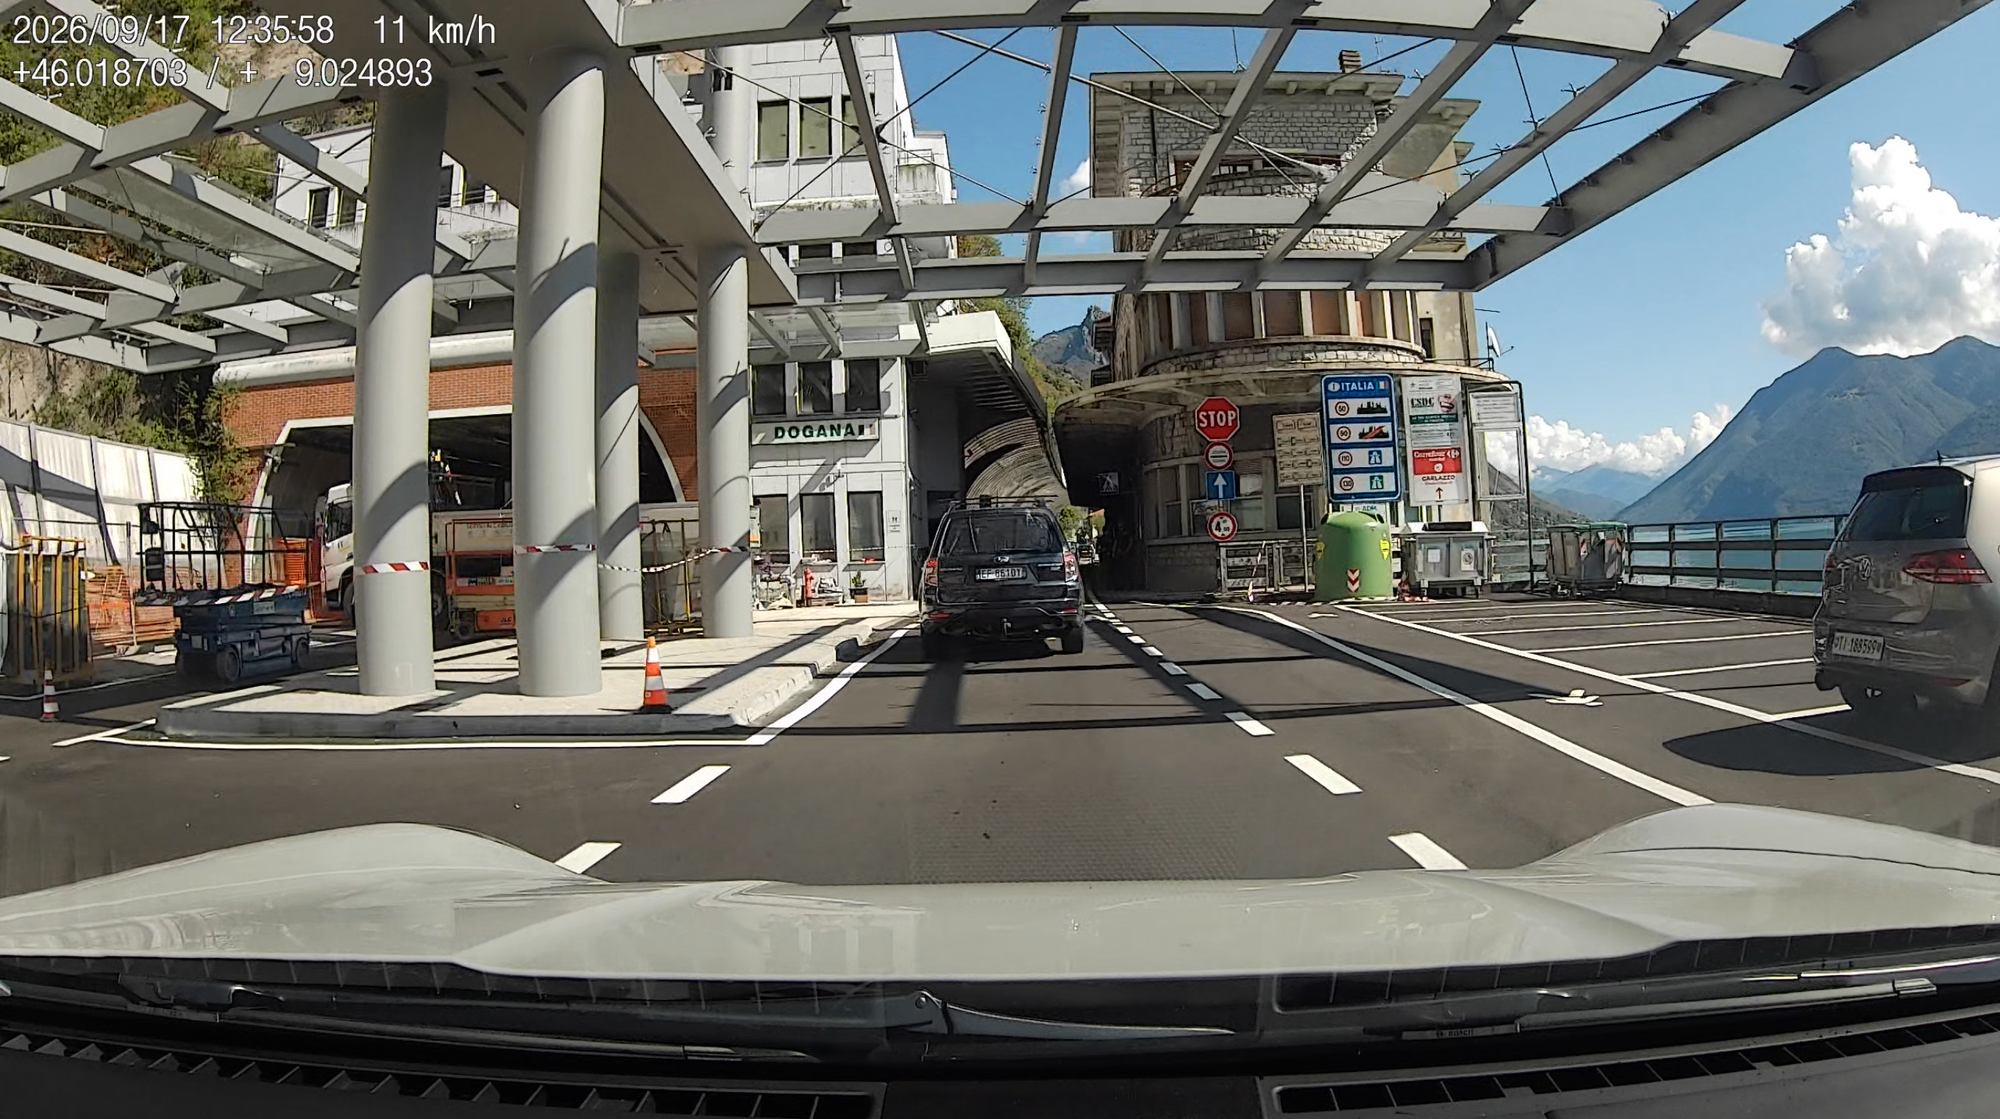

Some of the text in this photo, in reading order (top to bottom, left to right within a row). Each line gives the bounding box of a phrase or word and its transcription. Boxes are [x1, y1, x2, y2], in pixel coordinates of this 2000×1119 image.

[1341, 382, 1375, 391] ITALIA
[1199, 410, 1236, 428] STOP
[774, 423, 855, 439] DOGANA
[1414, 450, 1446, 458] Carrefour
[1422, 474, 1455, 482] CARLAZZO
